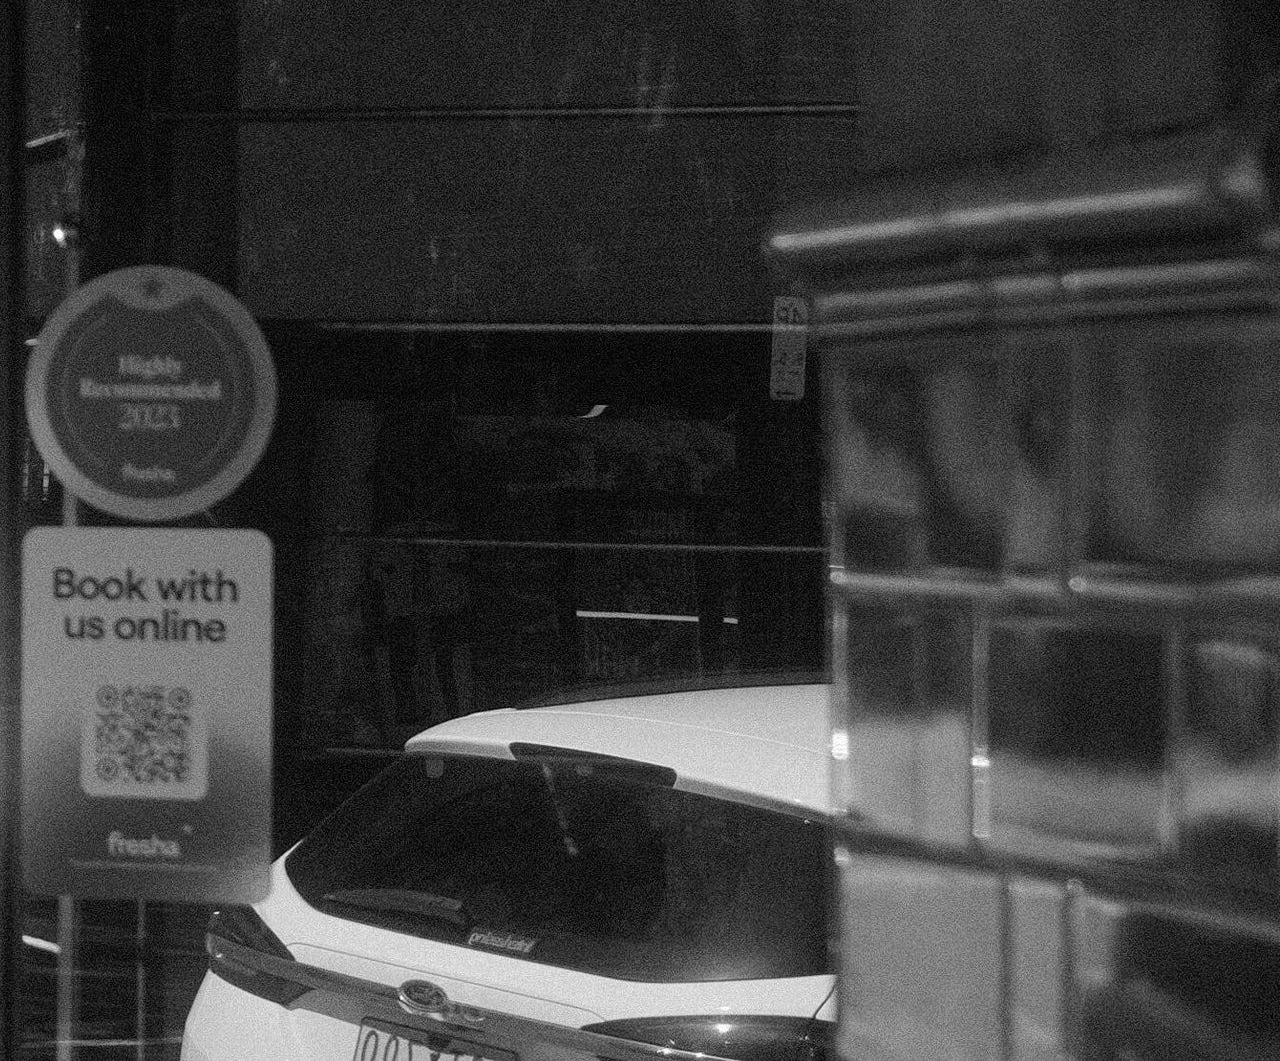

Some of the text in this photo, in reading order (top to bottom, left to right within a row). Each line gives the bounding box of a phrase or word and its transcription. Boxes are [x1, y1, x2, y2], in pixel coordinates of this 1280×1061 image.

[53, 568, 238, 605] Book with
[64, 607, 228, 643] us online
[107, 830, 182, 858] fresha
